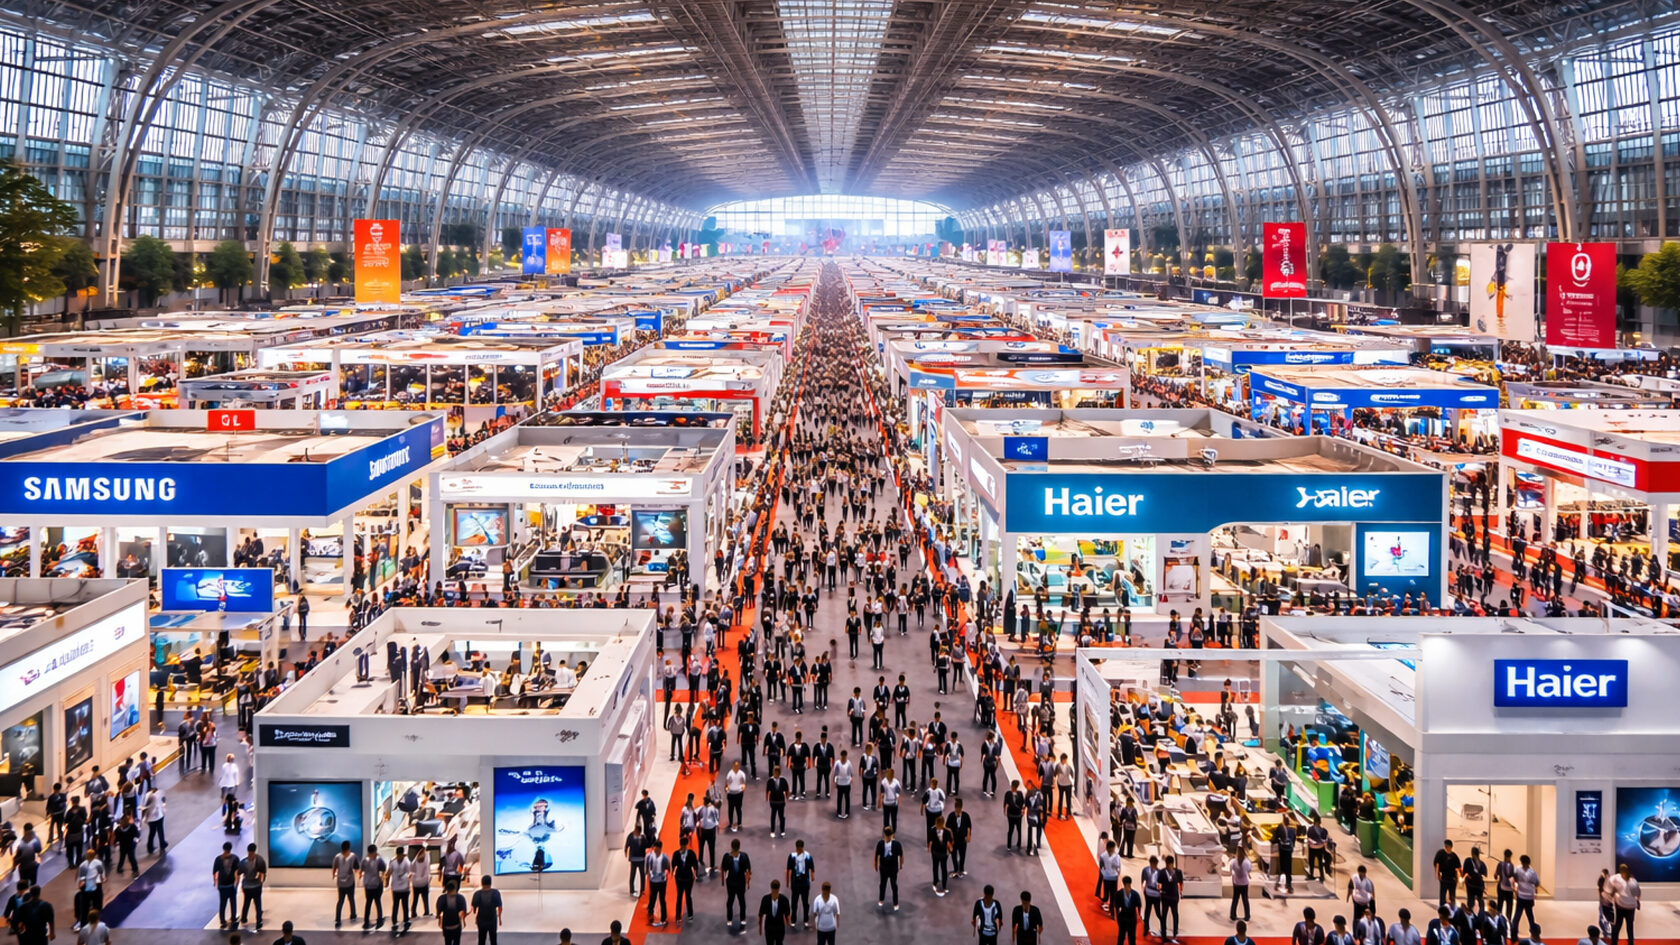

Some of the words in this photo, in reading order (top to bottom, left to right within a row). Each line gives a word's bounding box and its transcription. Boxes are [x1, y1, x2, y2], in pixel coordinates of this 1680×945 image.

[24, 476, 176, 501] SAMSUNG
[1044, 486, 1144, 516] Haier
[1506, 665, 1616, 698] Haier
